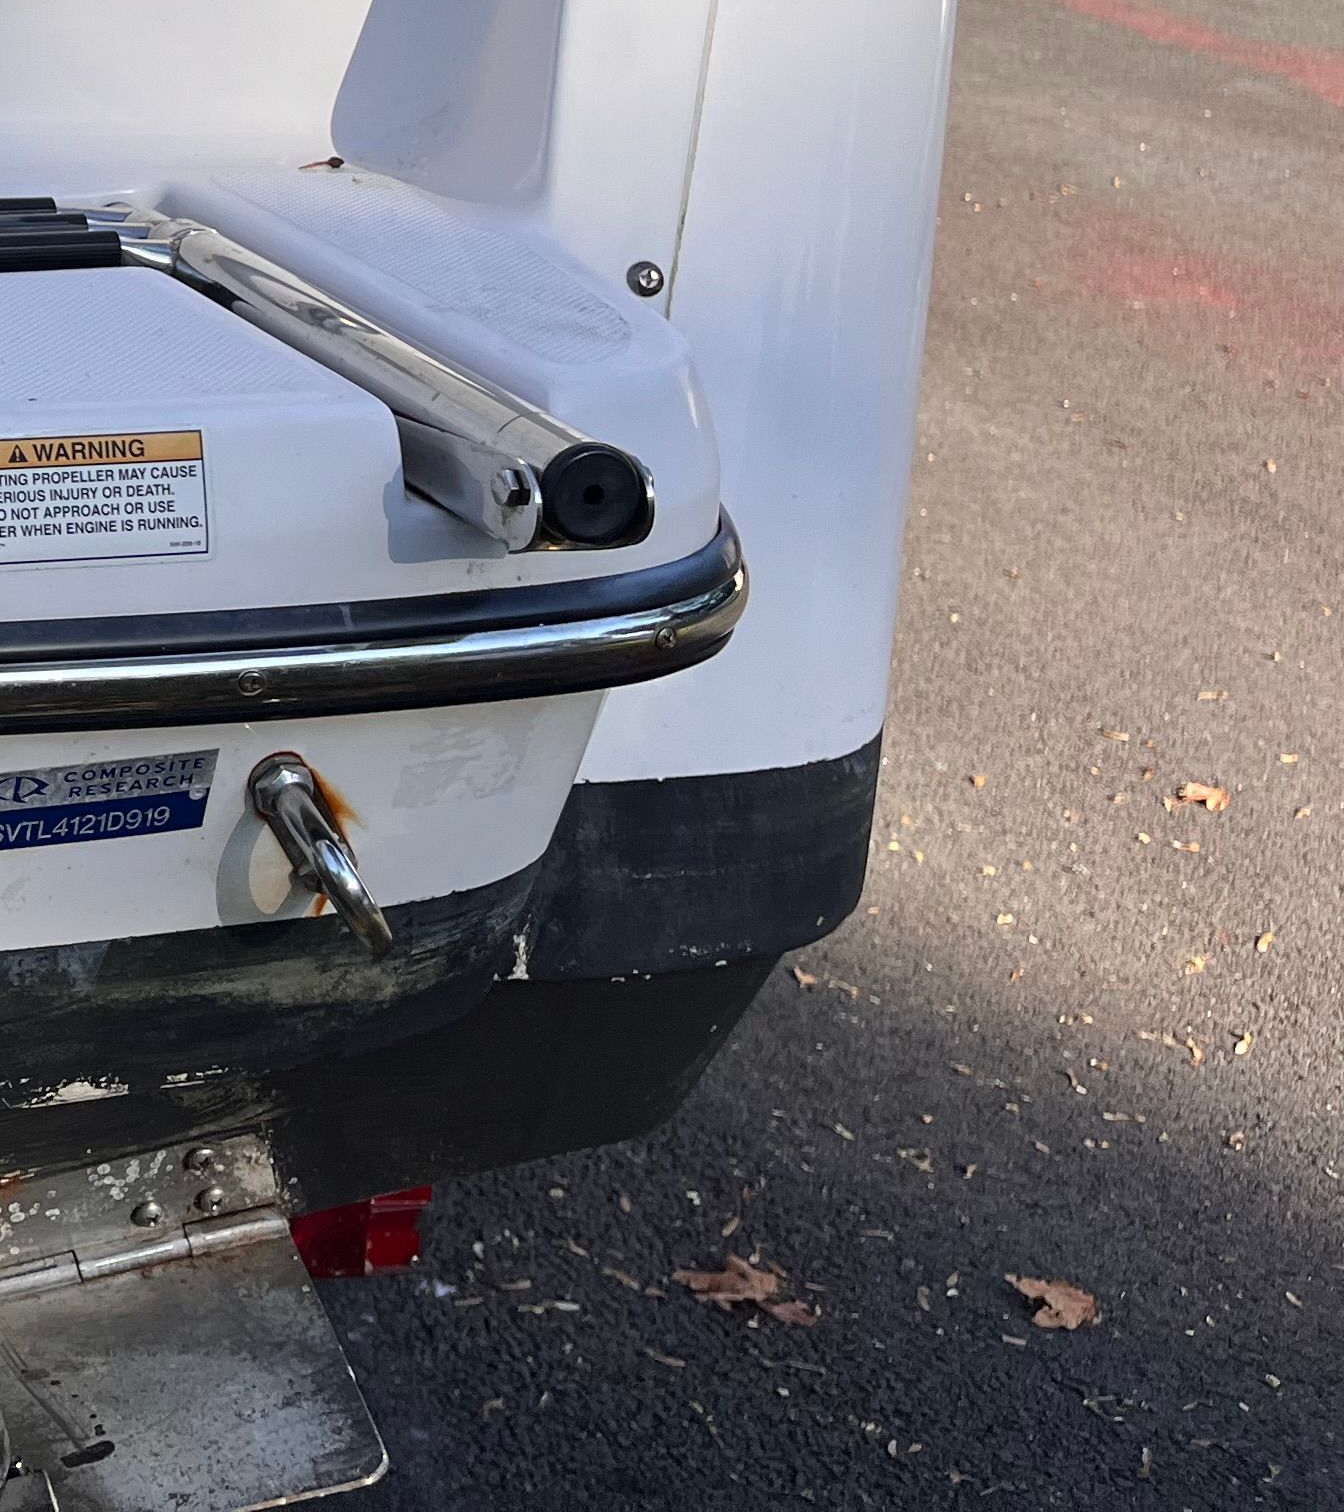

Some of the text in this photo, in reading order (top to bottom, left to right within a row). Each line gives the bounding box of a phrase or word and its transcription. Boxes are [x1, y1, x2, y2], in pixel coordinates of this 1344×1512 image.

[32, 439, 145, 462] WARNING
[32, 469, 115, 485] PROPELLER
[118, 467, 147, 481] MAY
[150, 465, 198, 480] CAUSE
[49, 486, 98, 501] INJURY
[102, 486, 123, 499] OR
[126, 483, 175, 498] DEATH.
[10, 506, 40, 520] NOT
[43, 503, 120, 519] APPROACH
[123, 501, 144, 515] OR
[148, 500, 176, 514] USE
[20, 522, 62, 537] WHEN
[66, 520, 118, 535] ENGINE
[121, 519, 134, 532] IS
[138, 515, 204, 531] RUNNING.
[63, 757, 206, 783] COMPOSITE
[68, 773, 195, 798] RESEARCH
